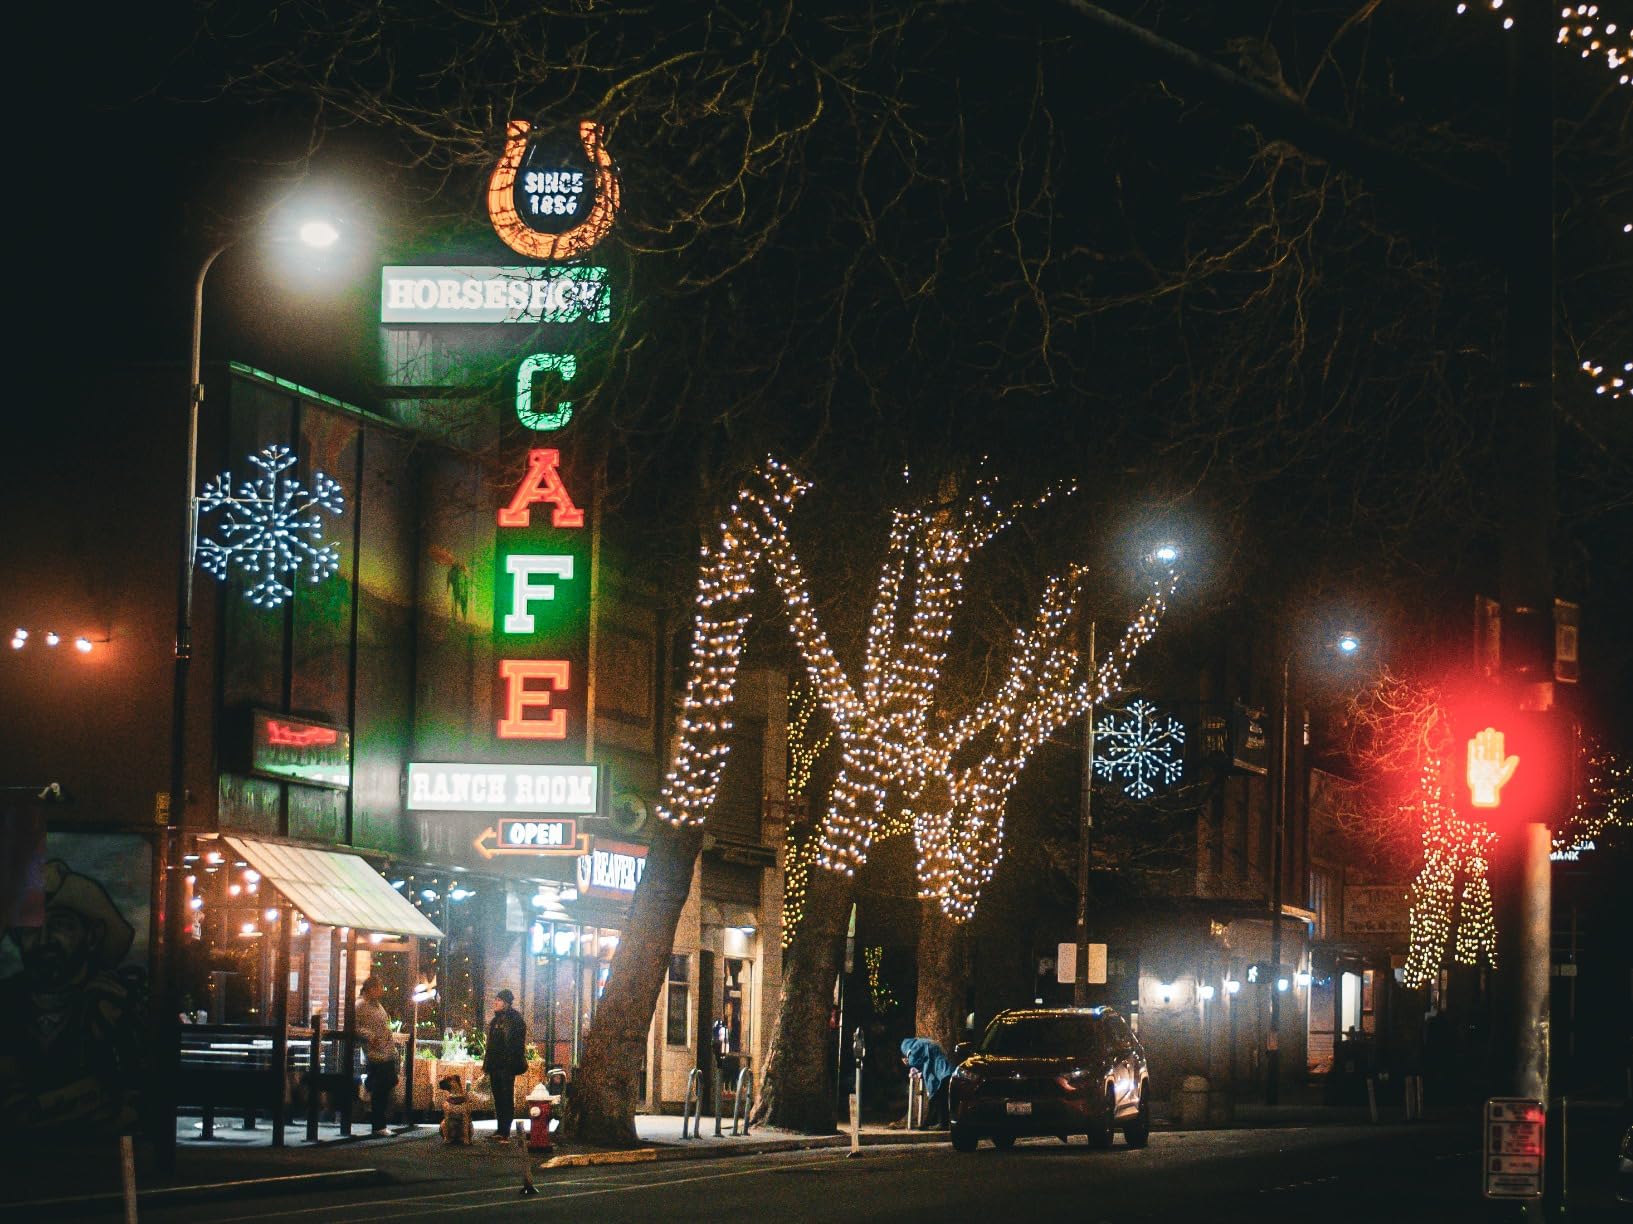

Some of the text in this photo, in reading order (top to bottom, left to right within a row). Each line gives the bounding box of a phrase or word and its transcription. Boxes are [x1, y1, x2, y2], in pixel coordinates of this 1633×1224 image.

[525, 172, 583, 194] SINCE
[497, 352, 584, 740] CAFE
[413, 773, 592, 805] RANCH ROOM
[510, 822, 562, 845] OPEN
[592, 849, 636, 891] BEAVER
